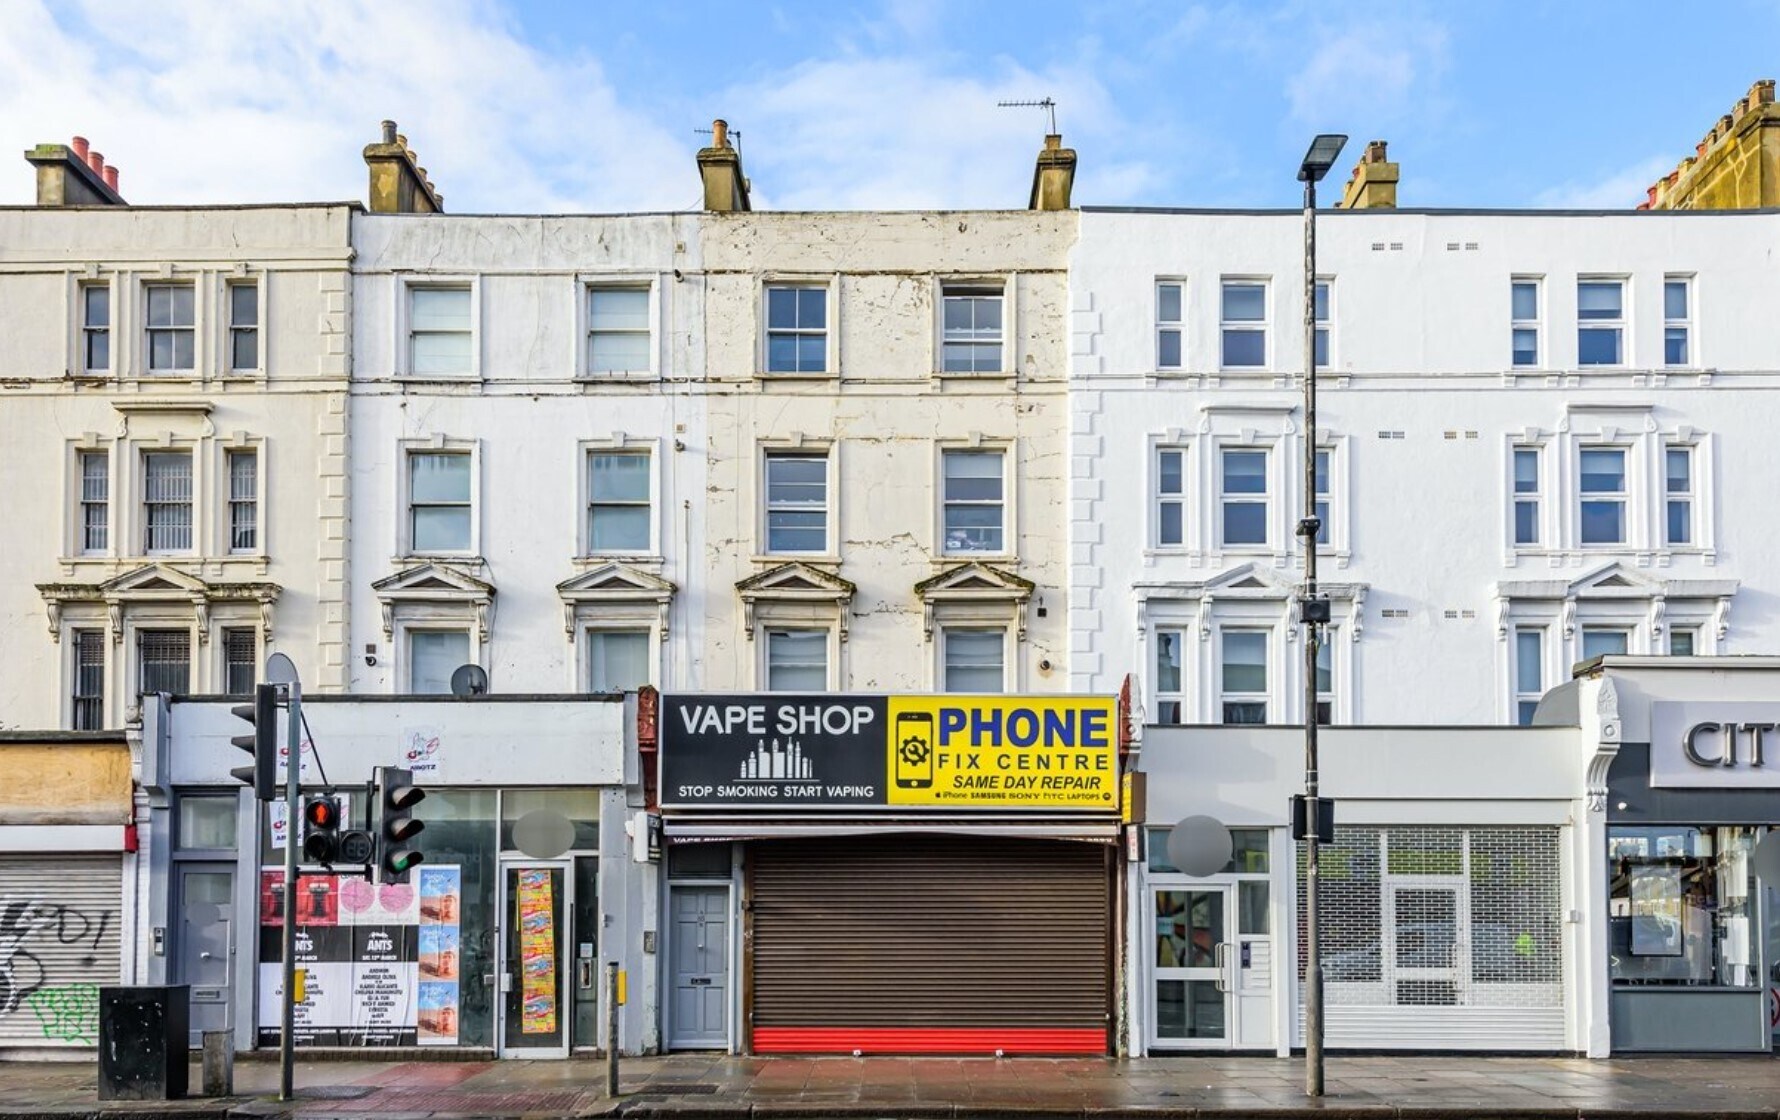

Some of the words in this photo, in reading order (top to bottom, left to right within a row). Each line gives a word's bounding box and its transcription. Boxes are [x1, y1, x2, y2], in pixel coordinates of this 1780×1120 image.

[679, 705, 766, 735] VAPE
[776, 704, 875, 735] SHOP
[938, 708, 1109, 748] PHONE
[1682, 721, 1780, 768] CIT
[937, 753, 981, 770] FIX
[996, 753, 1109, 770] CENTRE
[953, 775, 1000, 789] SAME
[1004, 776, 1037, 789] DAY
[1045, 776, 1102, 789] REPAIR
[678, 785, 713, 797] STOP
[716, 785, 778, 797] SMOKING
[783, 785, 823, 797] START
[826, 785, 875, 797] VAPING
[943, 791, 968, 799] iPhone
[970, 792, 1006, 800] SAMSUNG
[1066, 793, 1100, 801] LAPTOPS
[295, 940, 314, 951] NTS
[367, 939, 393, 951] ANTS
